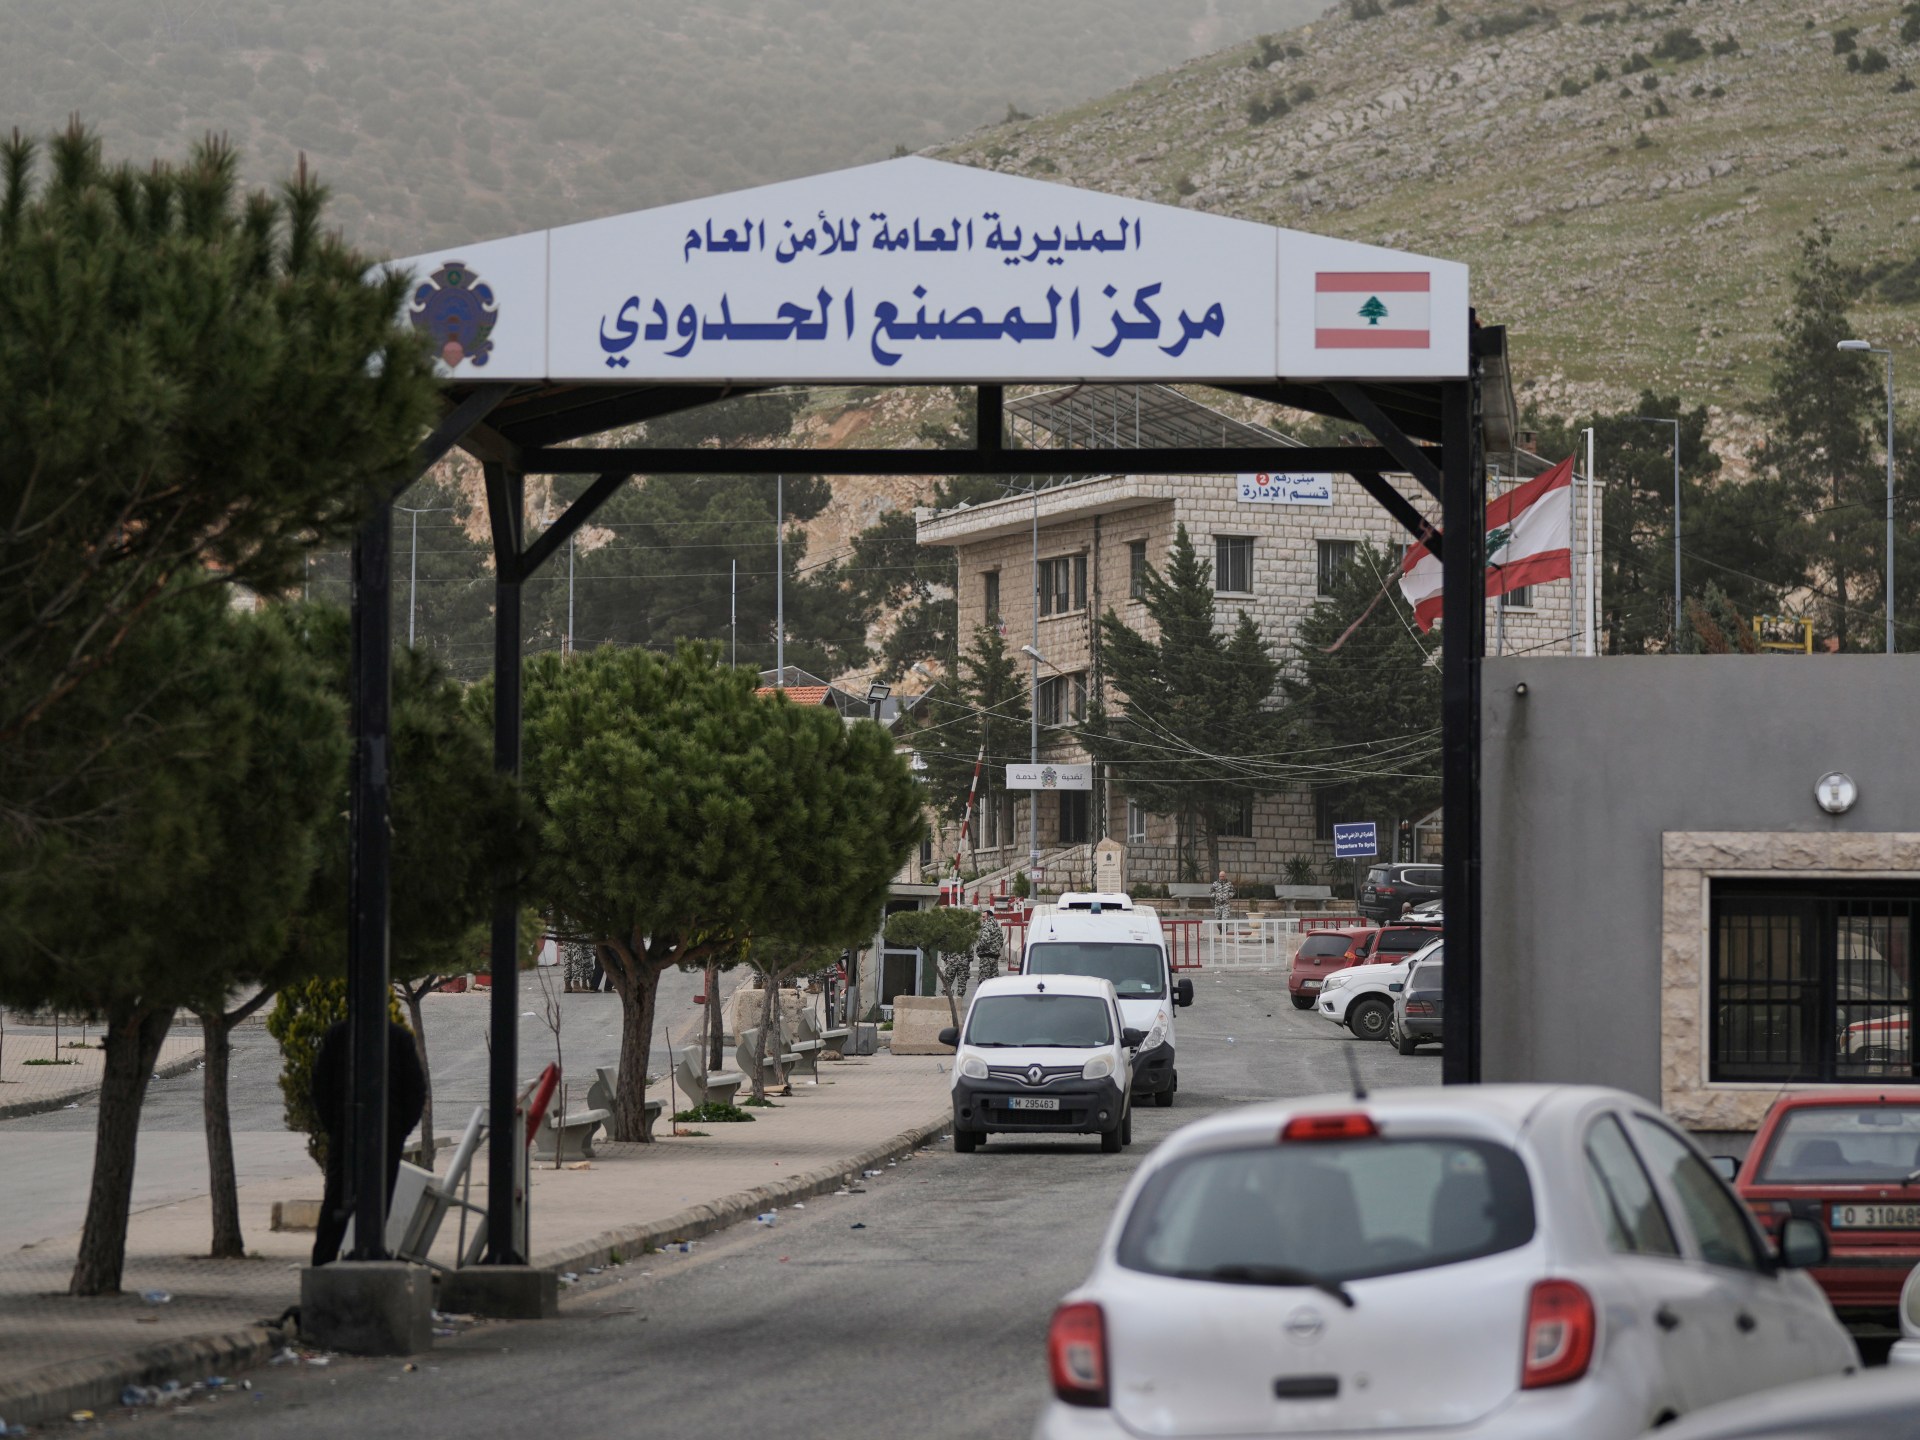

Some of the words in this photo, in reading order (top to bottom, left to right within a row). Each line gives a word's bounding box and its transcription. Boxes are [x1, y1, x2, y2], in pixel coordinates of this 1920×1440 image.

[683, 217, 767, 263] العام
[775, 209, 862, 264] للأمن
[869, 212, 975, 253] العامة
[982, 212, 1142, 266] المديرية
[598, 286, 856, 370] الحدودي
[869, 285, 1082, 368] المصنع
[1092, 282, 1226, 359] مركز
[1259, 474, 1267, 484] 2
[1289, 486, 1329, 502] قسم
[1015, 1099, 1021, 1108] M
[1025, 1099, 1054, 1109] 295463
